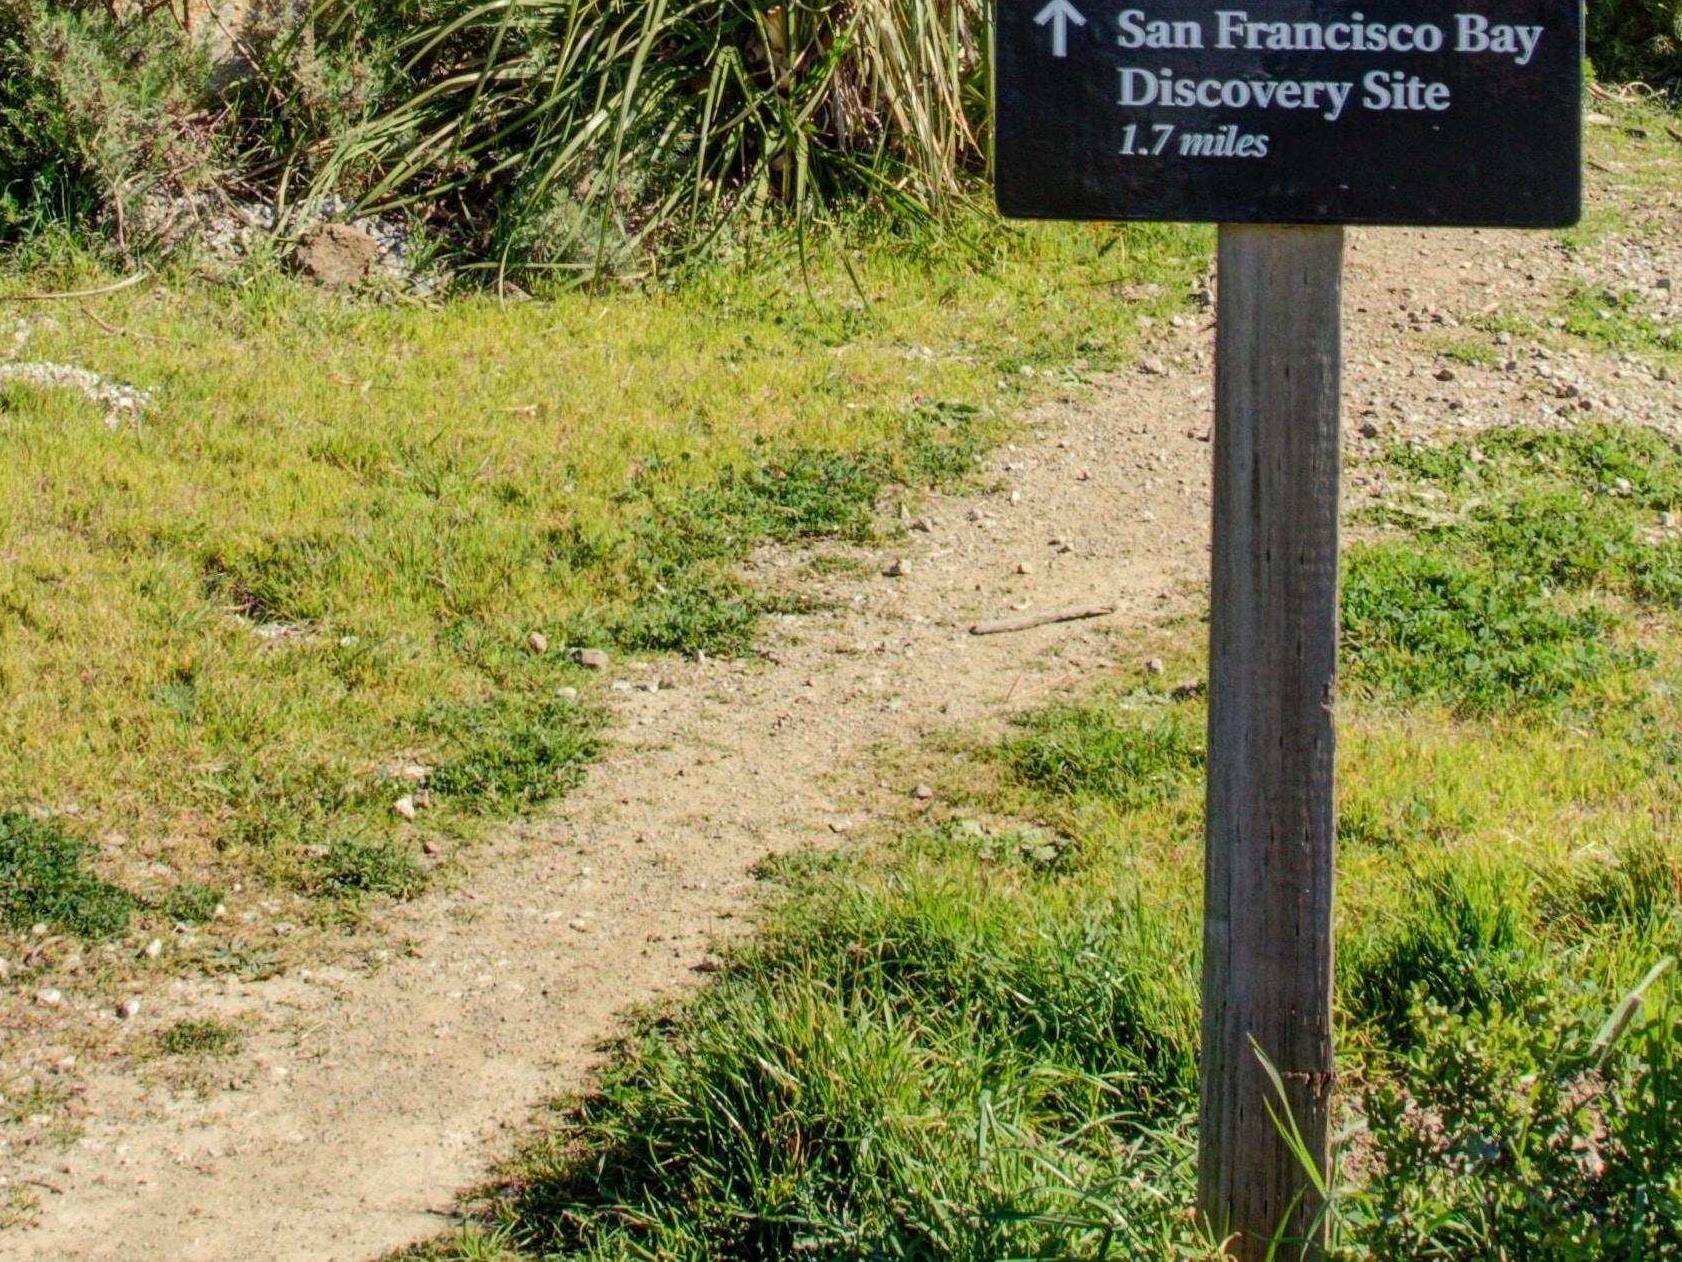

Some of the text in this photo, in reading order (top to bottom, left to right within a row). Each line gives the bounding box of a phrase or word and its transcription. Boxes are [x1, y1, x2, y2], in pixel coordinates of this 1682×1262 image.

[1117, 9, 1545, 64] San Francisco Bay
[1117, 67, 1451, 119] Discovery Site
[1118, 123, 1270, 158] 1.7 miles
